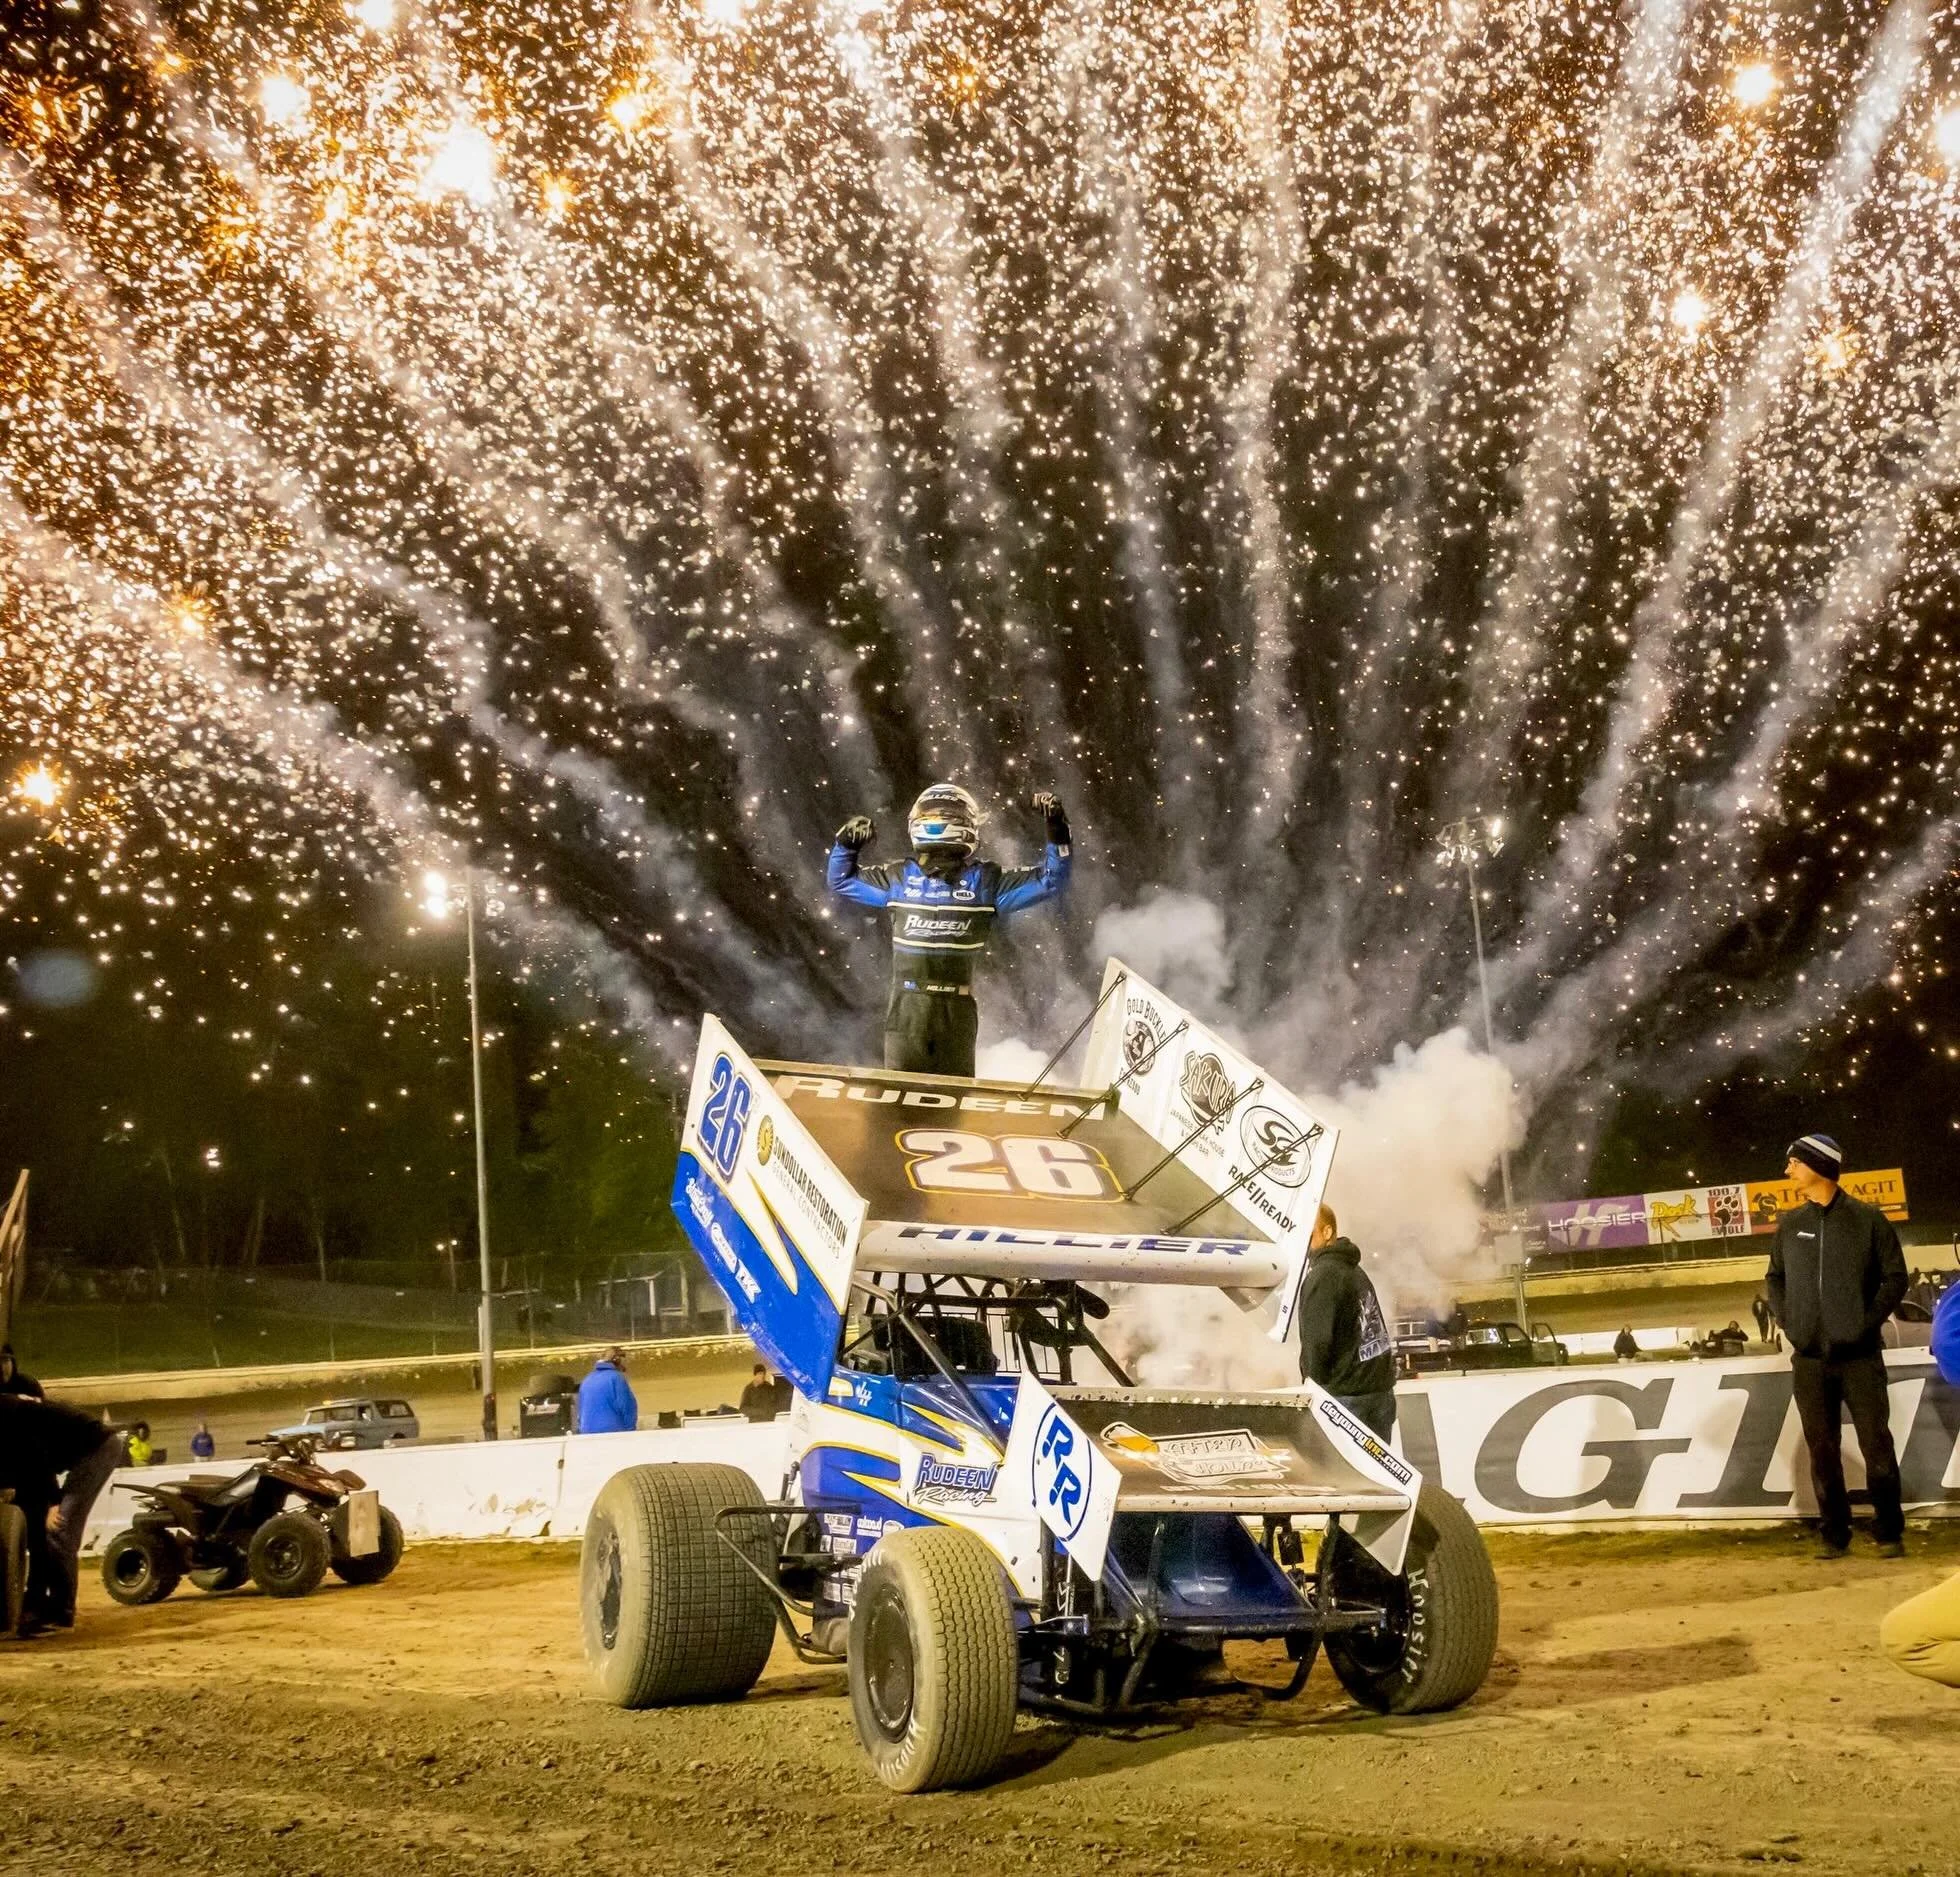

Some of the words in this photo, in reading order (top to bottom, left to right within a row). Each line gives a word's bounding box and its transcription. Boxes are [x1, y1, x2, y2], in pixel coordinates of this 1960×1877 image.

[904, 914, 971, 931] RUDEEN
[698, 1052, 752, 1178] 26
[773, 1075, 1106, 1120] RUDEEN
[900, 1130, 1115, 1200] 26
[773, 1136, 808, 1192] SUNDOLLAR
[806, 1177, 849, 1247] RESTORATION
[1547, 1211, 1646, 1233] HOOSIER
[898, 1226, 1251, 1256] HILLIER
[914, 1453, 997, 1490] RUDEEN
[915, 1486, 997, 1507] Racing
